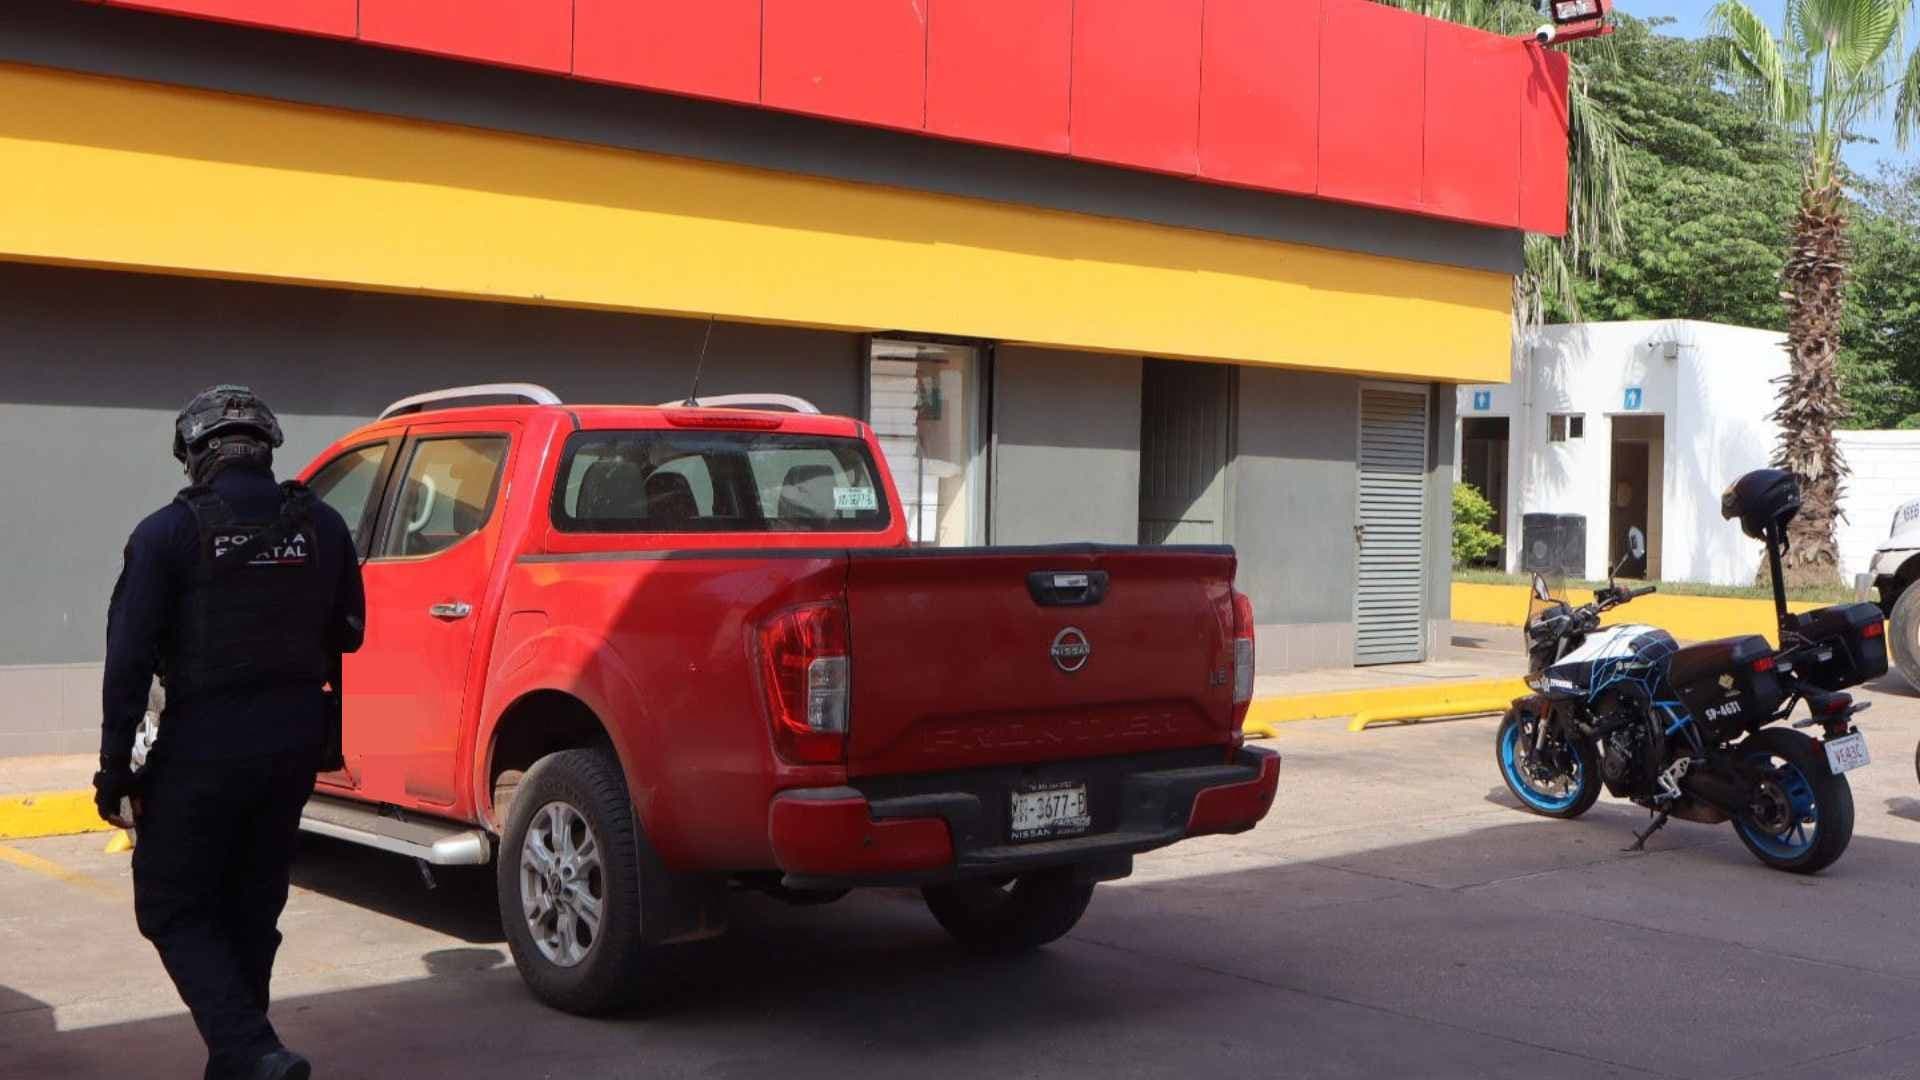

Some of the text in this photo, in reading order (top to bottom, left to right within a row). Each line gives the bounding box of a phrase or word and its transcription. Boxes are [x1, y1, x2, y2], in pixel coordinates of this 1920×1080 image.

[1050, 645, 1090, 657] NISSAN
[1705, 701, 1741, 720] SP-4631
[1011, 828, 1051, 841] NISSAN
